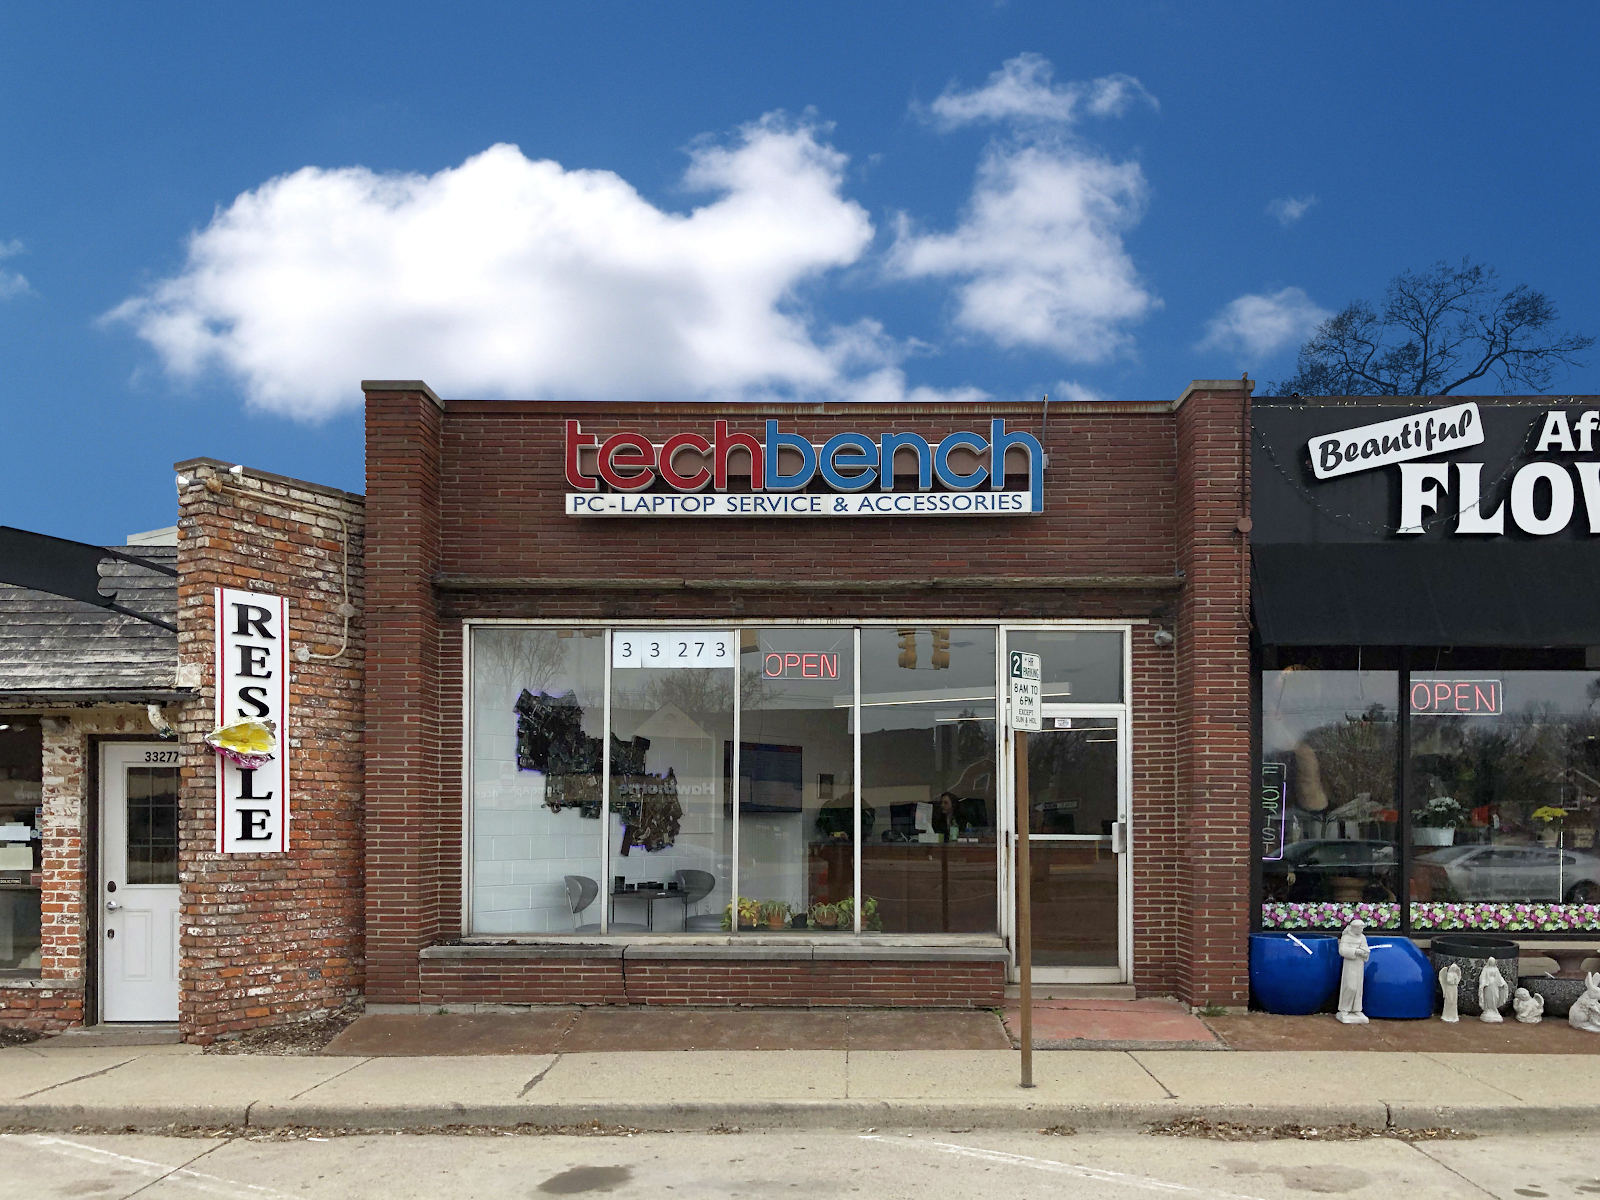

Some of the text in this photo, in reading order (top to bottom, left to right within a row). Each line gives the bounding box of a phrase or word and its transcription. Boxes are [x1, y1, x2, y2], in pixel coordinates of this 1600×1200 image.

[1318, 409, 1473, 472] Beautiful
[1535, 410, 1600, 452] Af
[565, 418, 1044, 512] techbench
[727, 495, 822, 513] SERVICE
[833, 495, 849, 513] &
[857, 494, 1024, 512] ACCESSORIES
[765, 653, 837, 678] OPEN
[1012, 655, 1021, 675] 2
[1022, 666, 1039, 679] PARKING
[1030, 684, 1039, 695] TO
[1411, 683, 1496, 712] OPEN
[231, 602, 277, 841] RESLE
[1015, 715, 1024, 723] SUN
[1018, 708, 1034, 716] EXCEPT
[144, 751, 179, 763] 33277
